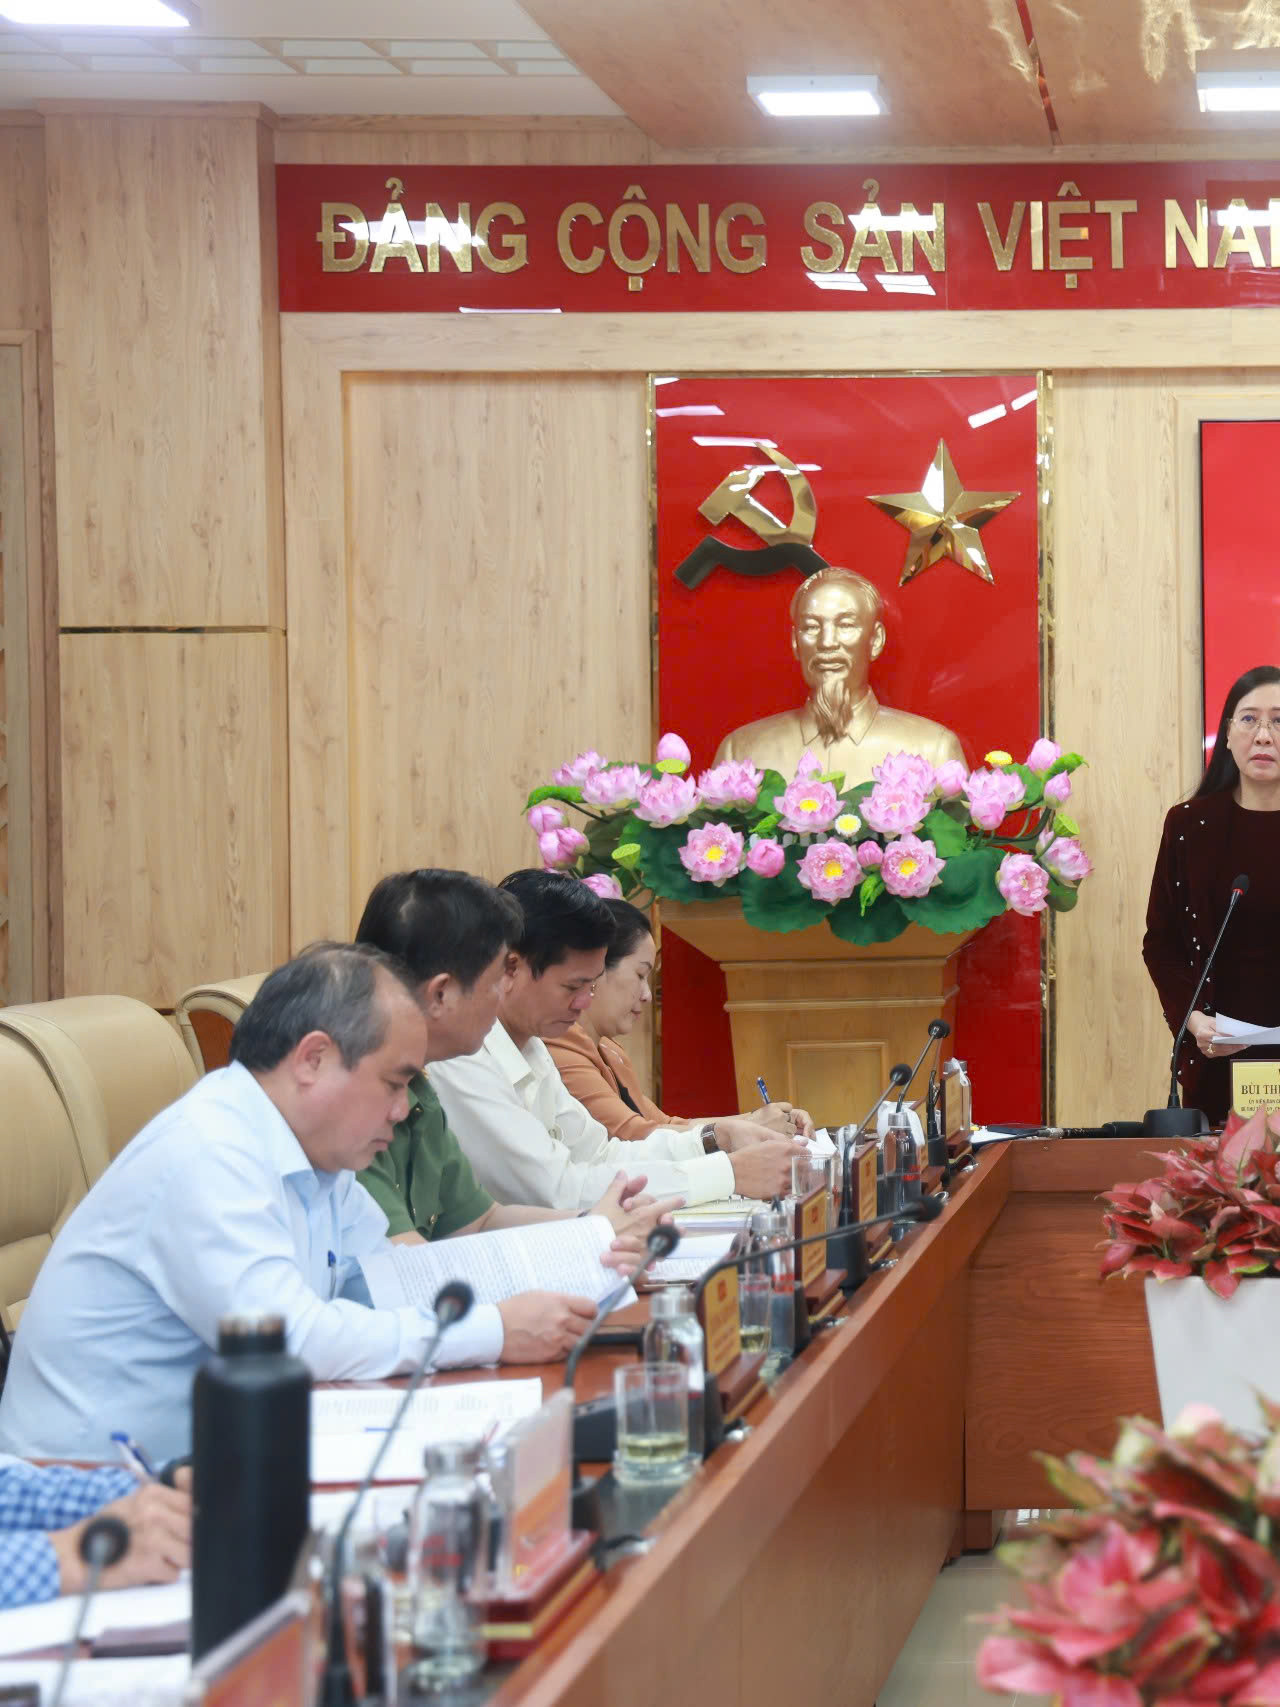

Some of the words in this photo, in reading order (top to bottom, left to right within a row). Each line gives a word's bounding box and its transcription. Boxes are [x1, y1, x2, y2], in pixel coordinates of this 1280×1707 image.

[317, 178, 529, 273] ĐẢNG
[557, 184, 767, 292] CỘNG
[800, 179, 947, 274] SẢN
[977, 181, 1138, 289] VIỆT
[1241, 1082, 1260, 1095] BÙI
